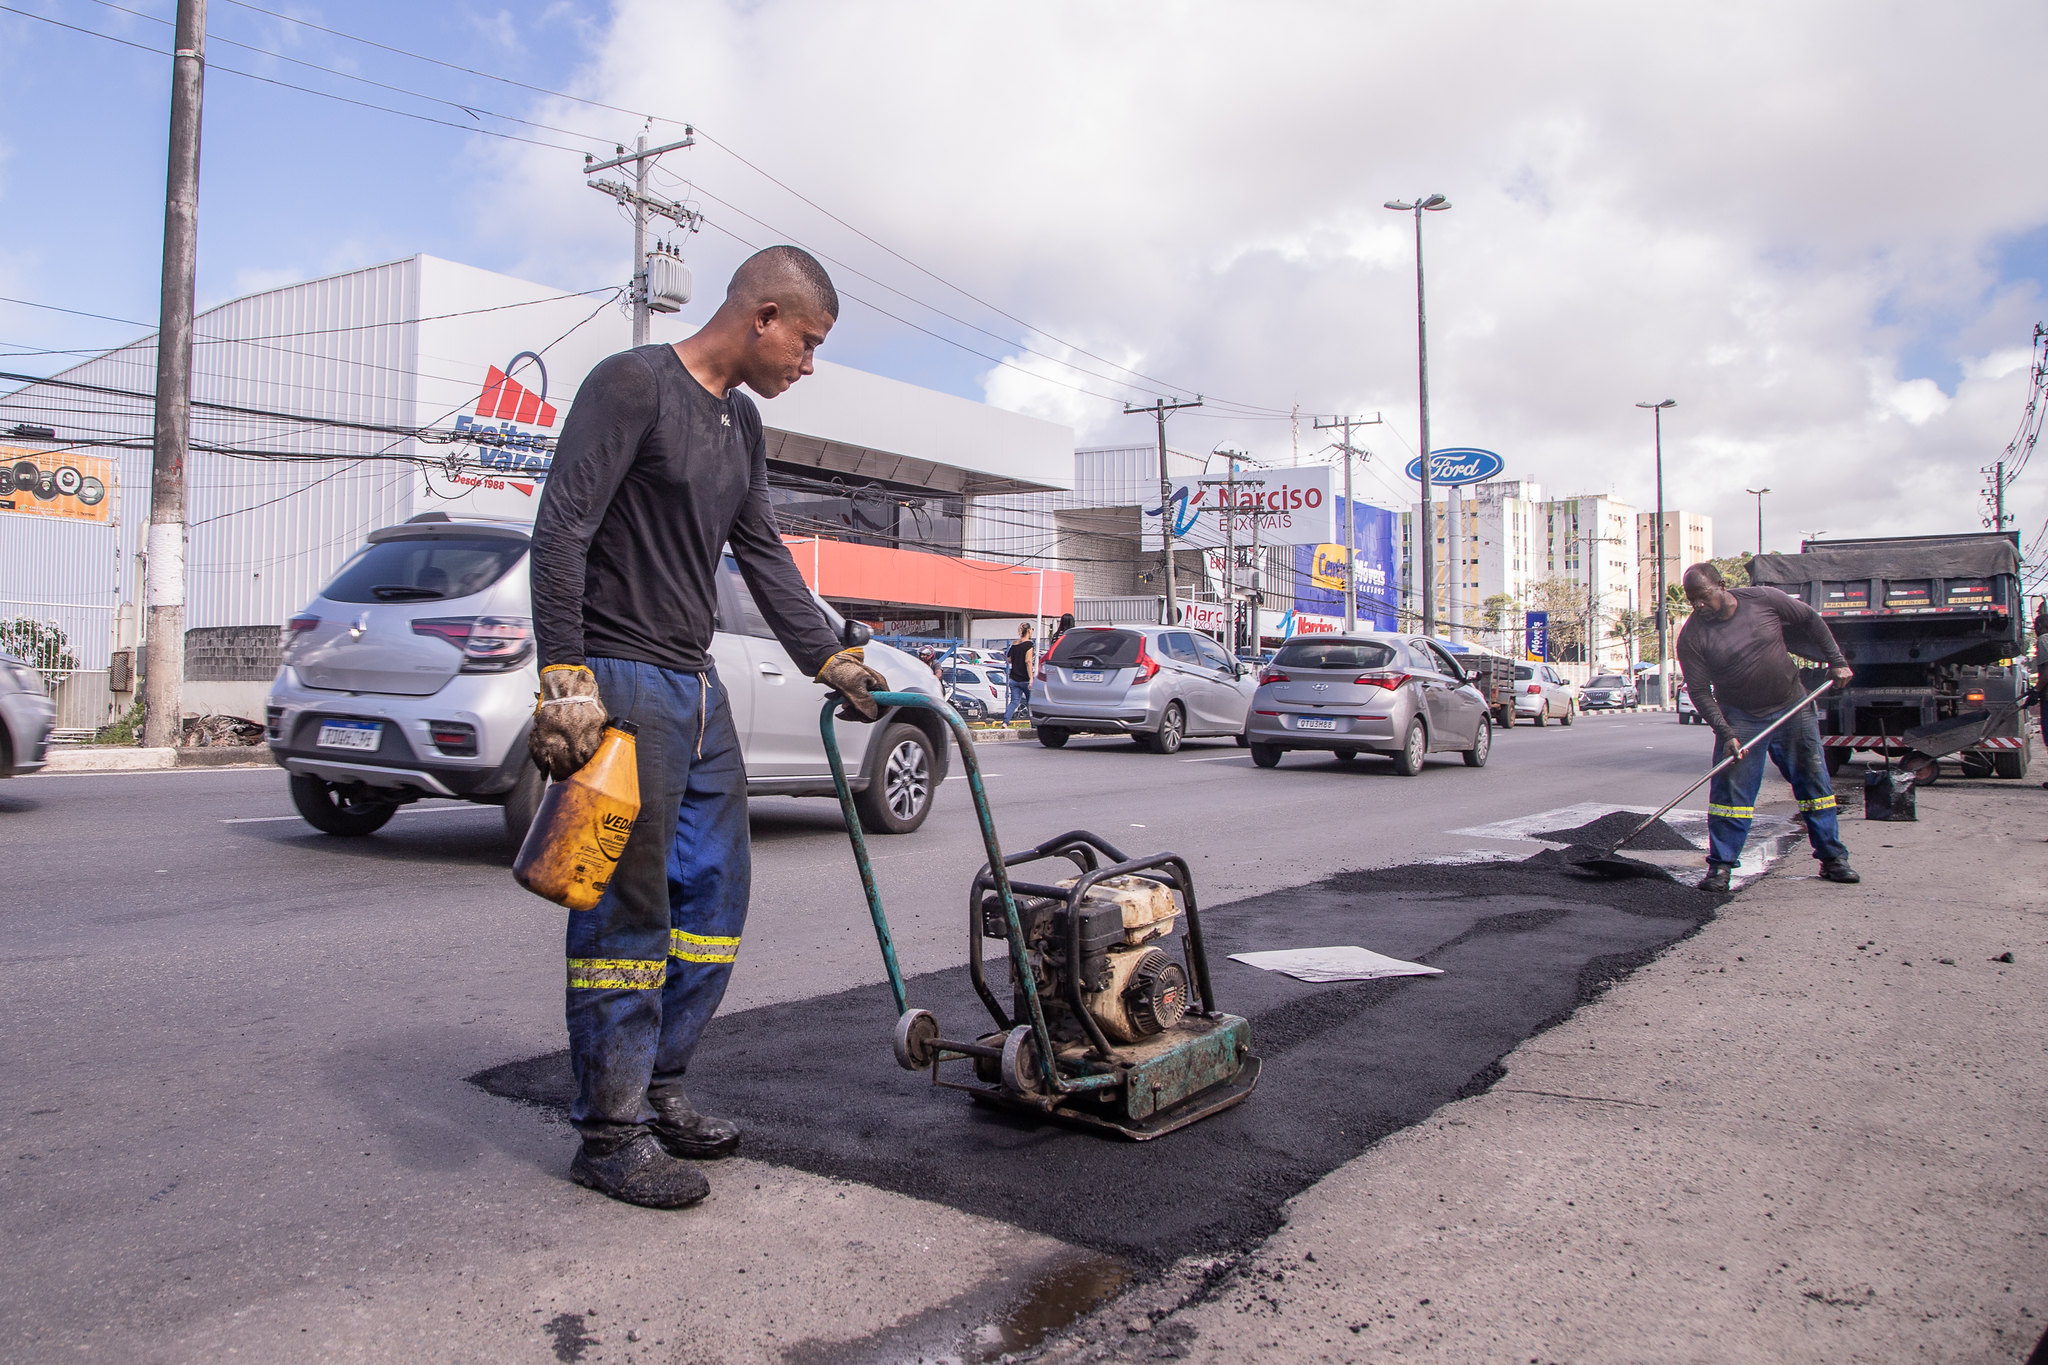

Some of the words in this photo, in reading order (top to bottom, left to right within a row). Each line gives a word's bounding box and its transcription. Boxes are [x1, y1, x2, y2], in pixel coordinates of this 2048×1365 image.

[480, 447, 552, 484] Varej
[1431, 455, 1481, 480] Ford
[454, 475, 481, 487] Desde
[484, 479, 505, 490] 1988
[1219, 485, 1323, 512] Narciso
[1185, 604, 1225, 624] Narc
[604, 813, 634, 832] VEDA
